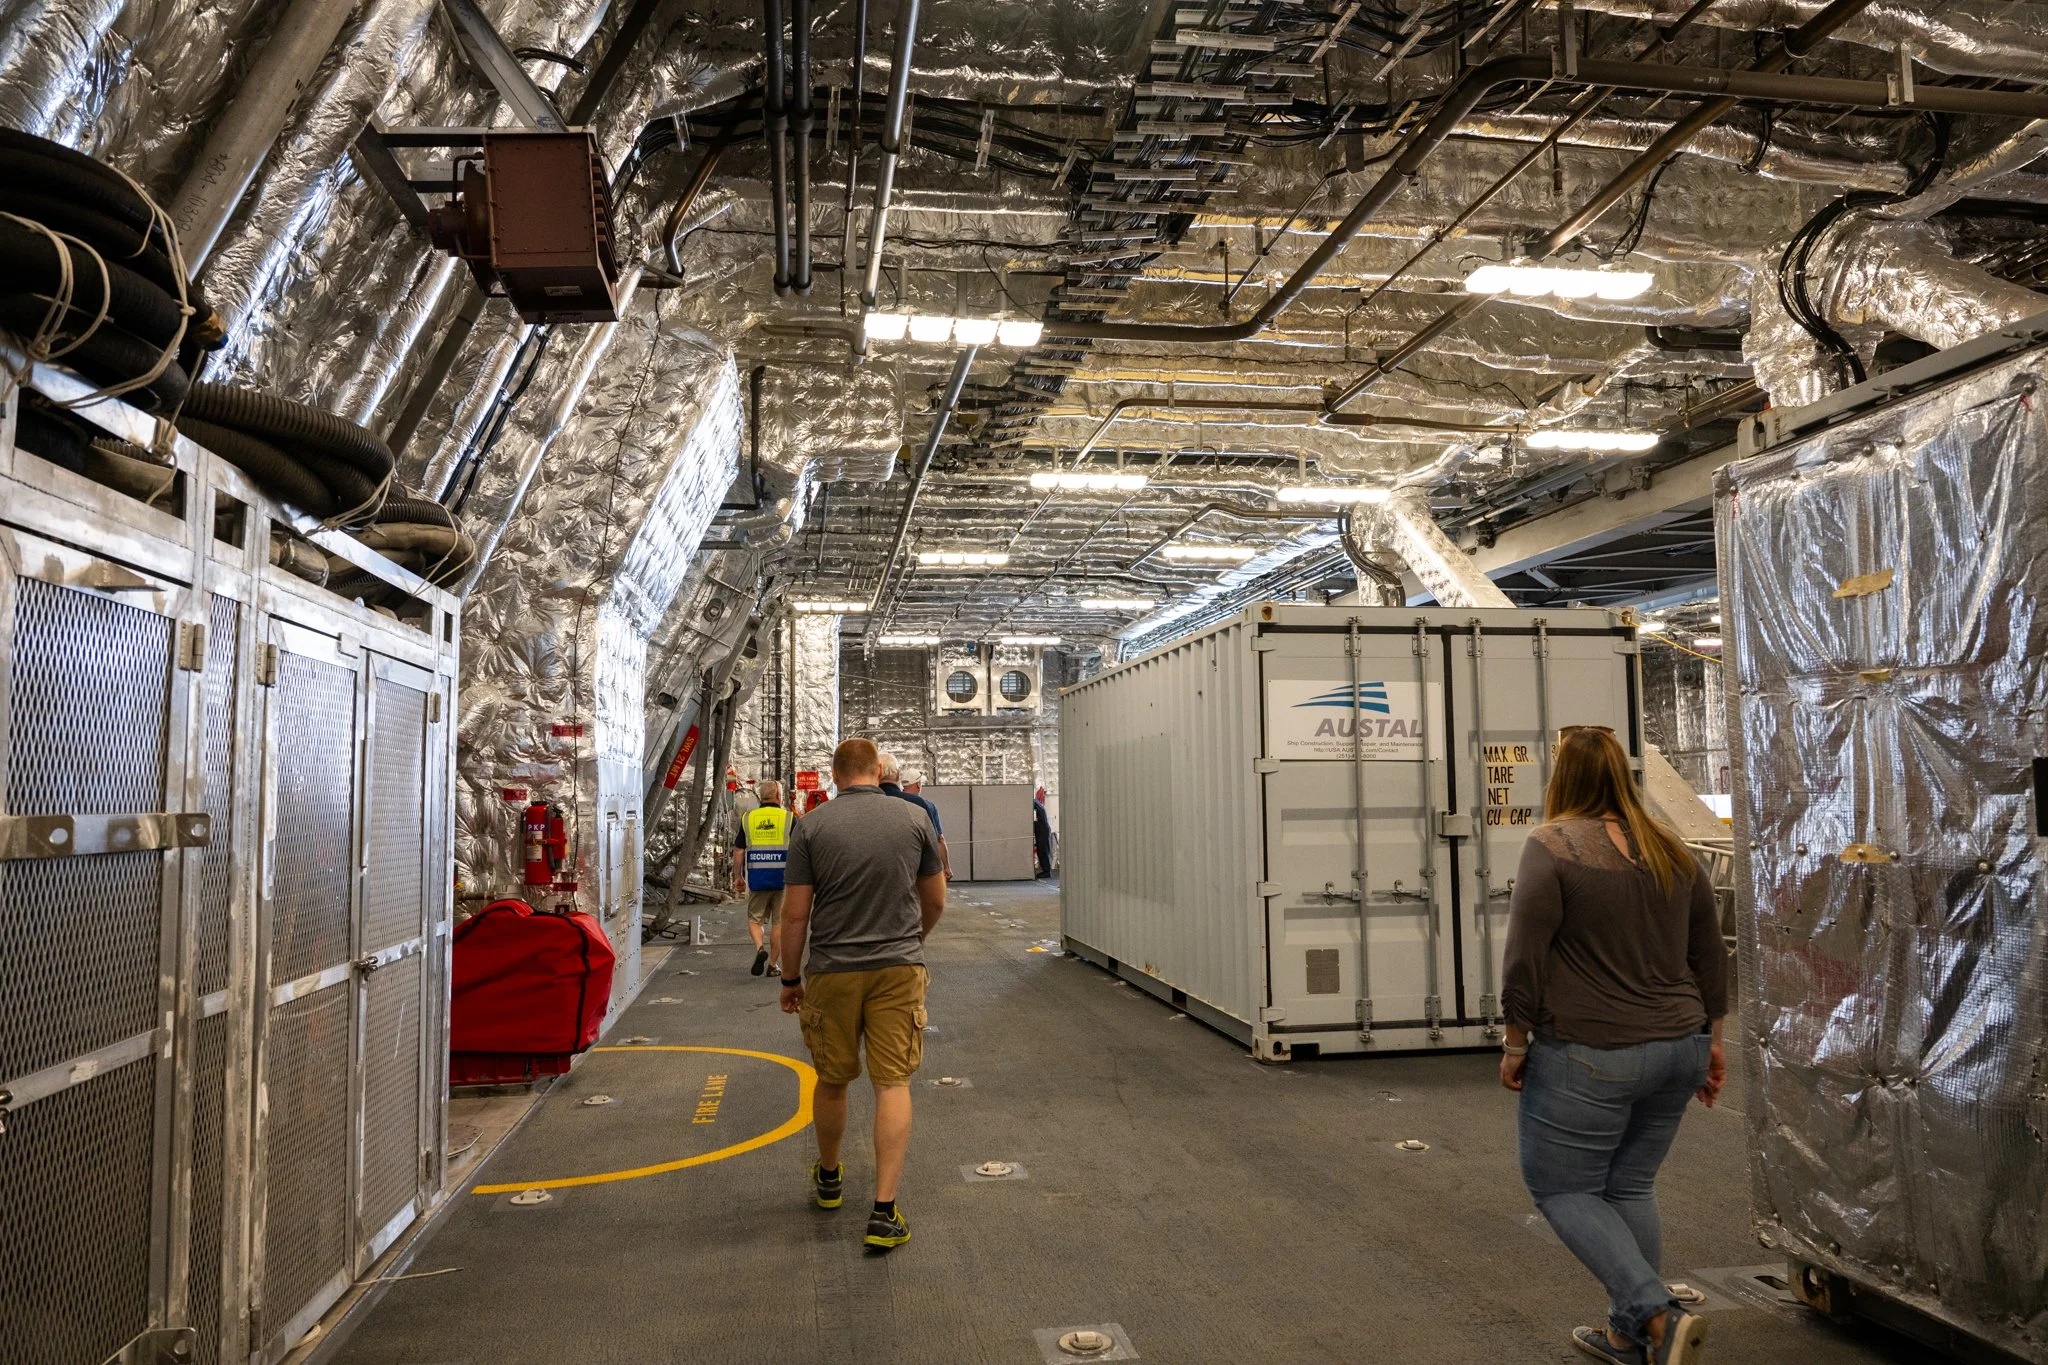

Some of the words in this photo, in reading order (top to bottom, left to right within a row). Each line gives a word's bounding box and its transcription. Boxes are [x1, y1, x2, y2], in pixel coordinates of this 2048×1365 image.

[1314, 718, 1424, 738] AUSTAL
[681, 736, 695, 753] SWL
[1483, 746, 1513, 763] MAX.
[1487, 766, 1515, 784] TARE
[1487, 787, 1510, 805] NET
[1487, 809, 1504, 826] CU.
[1510, 808, 1535, 825] CAP.
[750, 853, 783, 861] SECURITY
[701, 1074, 728, 1098] LANE
[692, 1100, 721, 1124] FIRE
